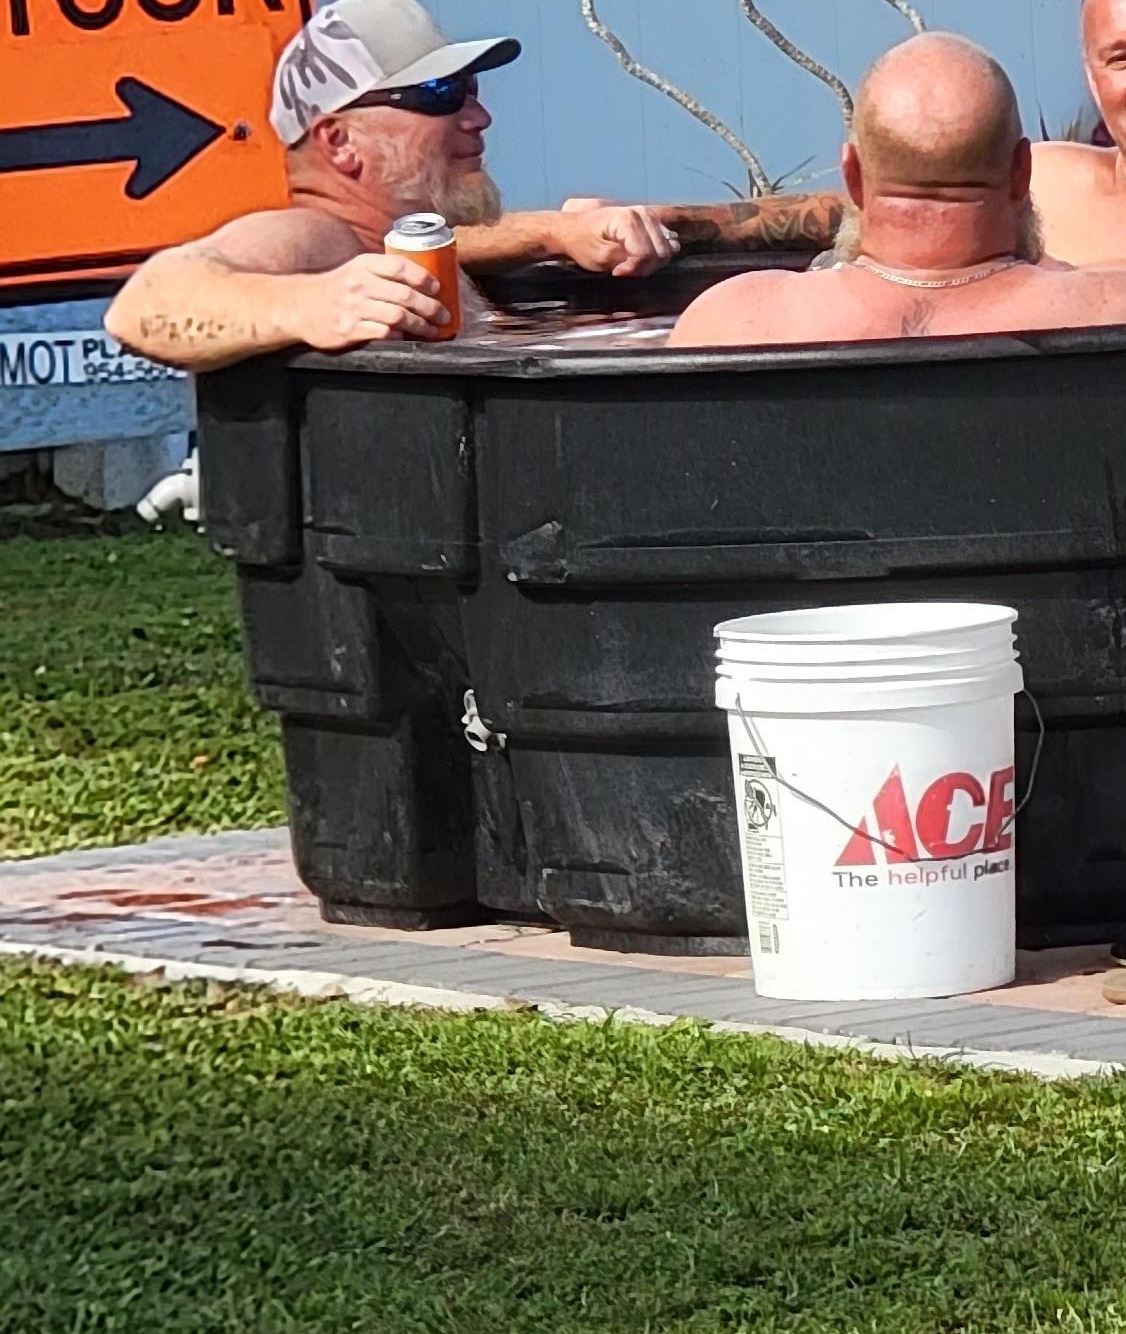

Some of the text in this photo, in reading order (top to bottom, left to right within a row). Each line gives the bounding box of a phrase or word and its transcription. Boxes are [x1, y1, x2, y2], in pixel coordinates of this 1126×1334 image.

[833, 763, 1015, 865] ACE
[832, 859, 1010, 888] The helpful place
